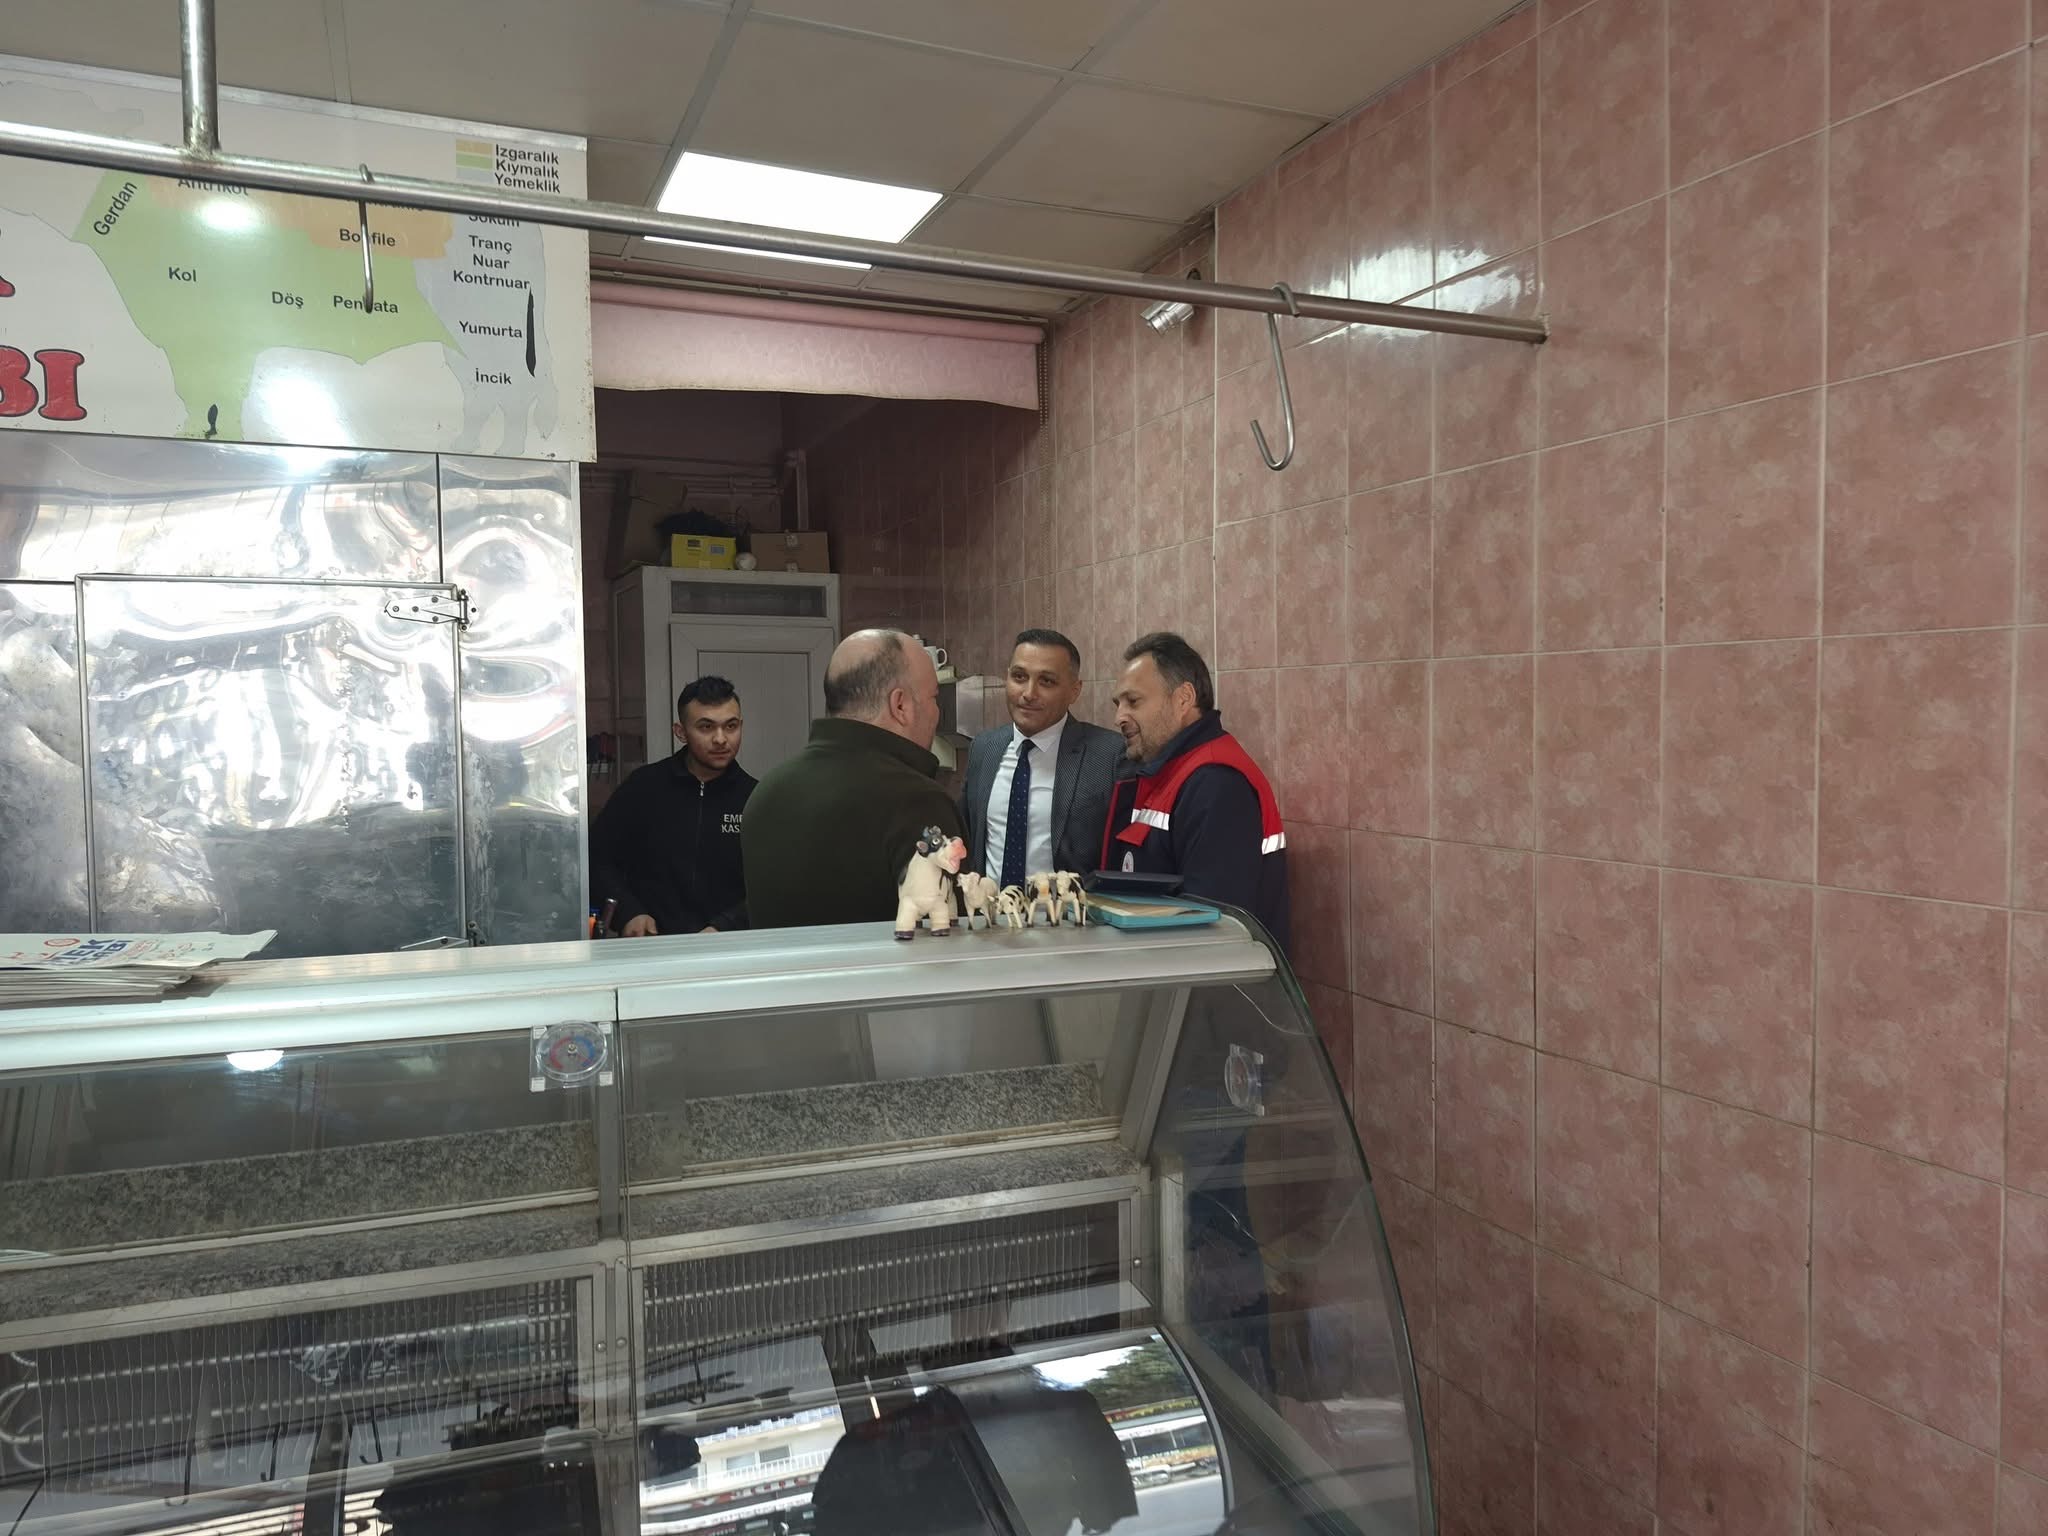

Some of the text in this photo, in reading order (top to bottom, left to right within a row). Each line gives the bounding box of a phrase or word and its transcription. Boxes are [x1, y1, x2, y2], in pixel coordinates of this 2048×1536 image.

[495, 143, 560, 166] Izgaralık
[495, 159, 560, 179] Kıymalık
[494, 172, 561, 193] Yemeklik
[93, 180, 138, 236] Gerdan
[339, 228, 396, 247] Bofile
[468, 234, 513, 255] Tranç
[473, 253, 510, 270] Nuar
[168, 266, 197, 282] Kol
[453, 270, 530, 290] Kontrnuar
[272, 291, 304, 310] Döş
[333, 295, 399, 314] Penata
[459, 320, 523, 339] Yumurta
[475, 367, 513, 385] İncik
